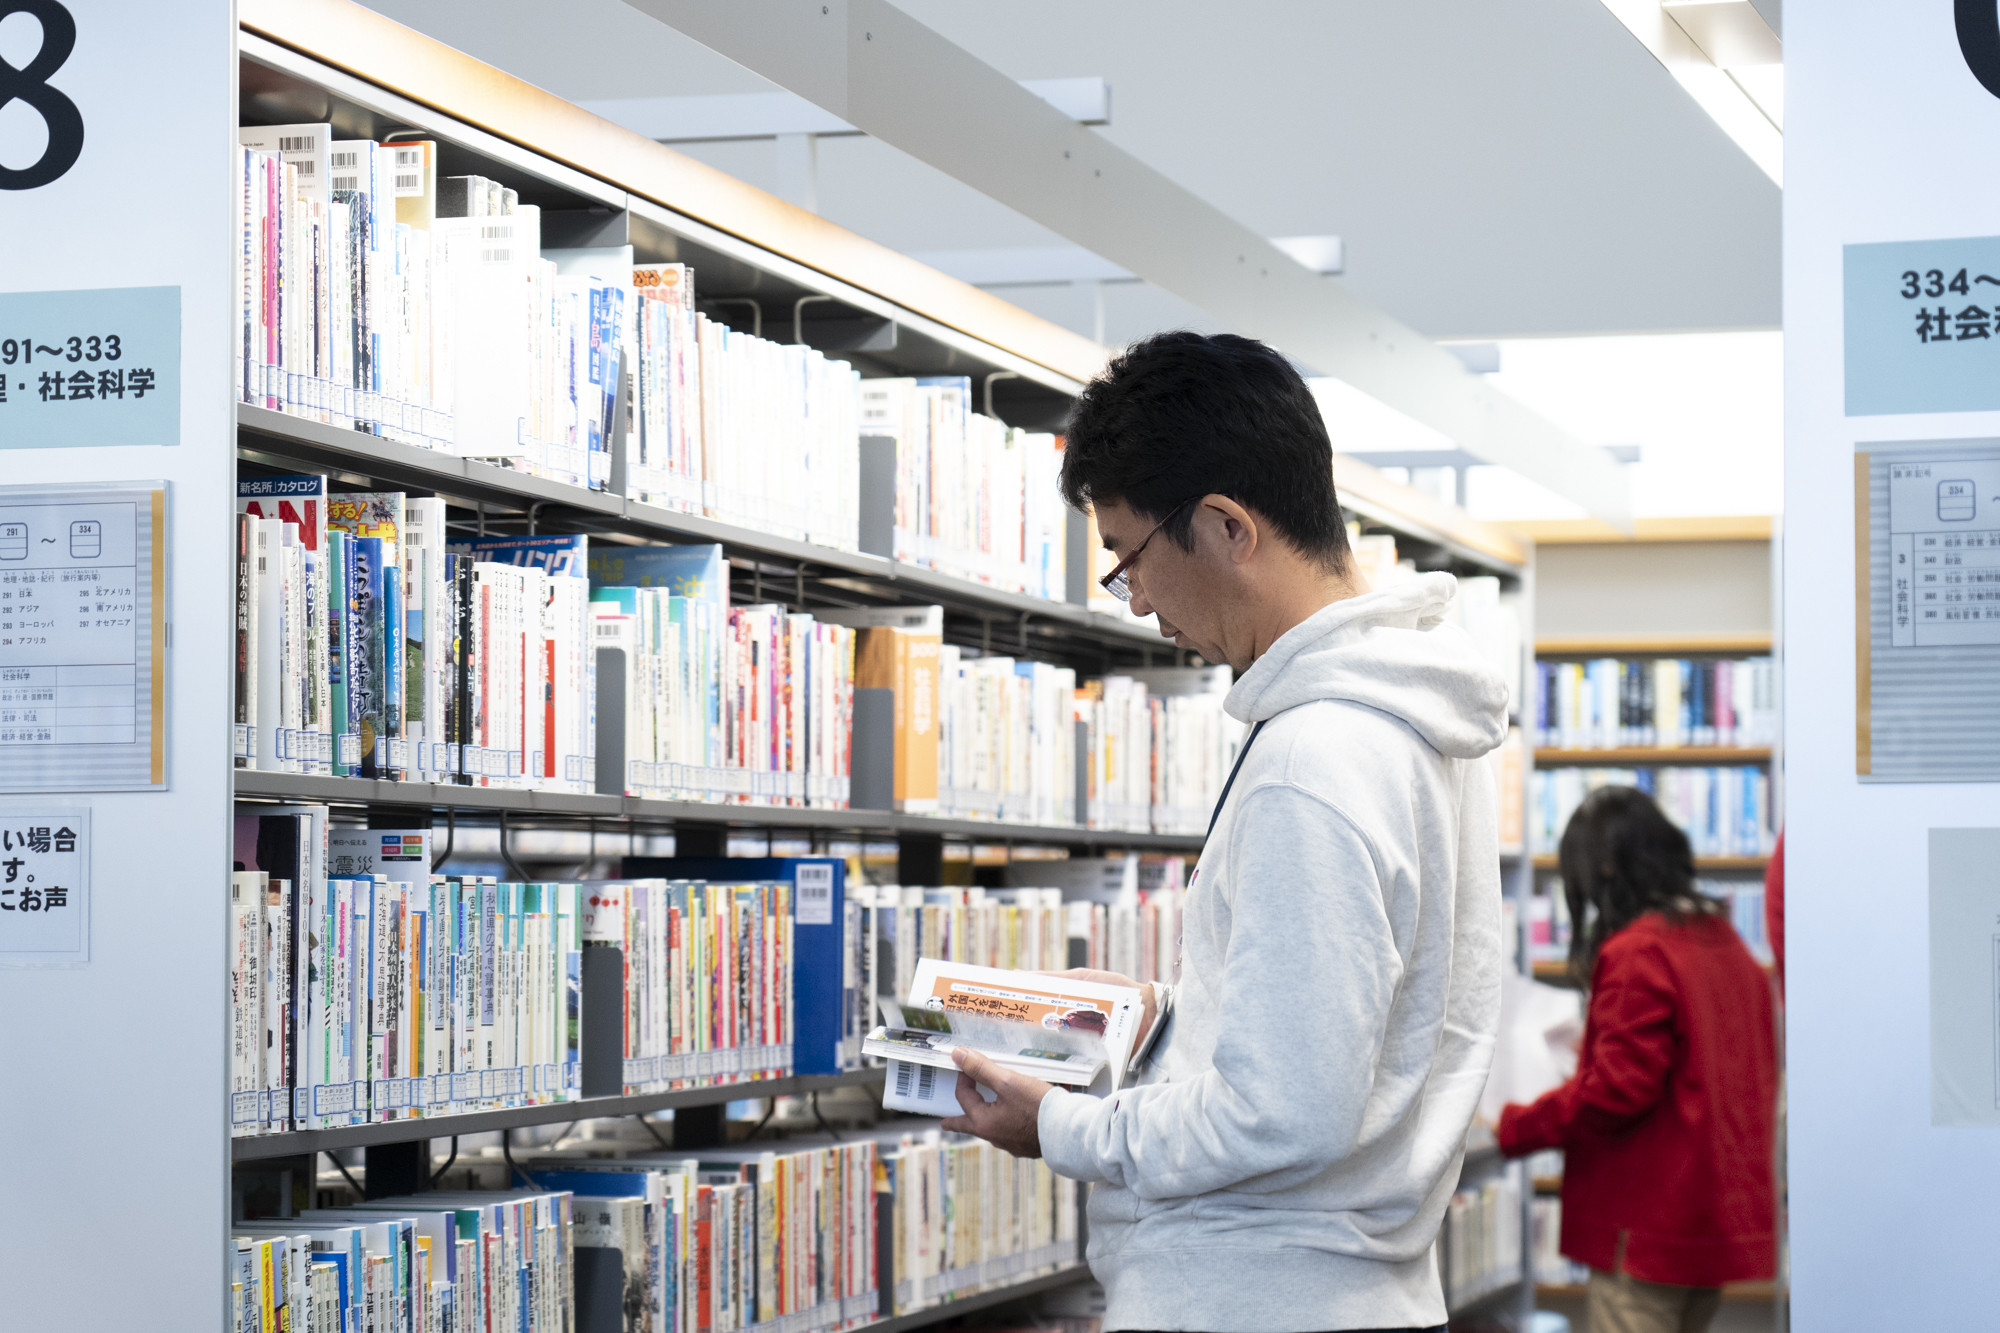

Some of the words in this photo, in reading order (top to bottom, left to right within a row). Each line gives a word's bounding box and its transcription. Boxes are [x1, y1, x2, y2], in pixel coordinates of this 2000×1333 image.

[0, 0, 84, 190] 8
[1915, 303, 2000, 344] 社会
[1949, 486, 1964, 495] 334
[6, 528, 18, 536] 291
[79, 525, 91, 533] 334
[19, 590, 33, 598] 日本
[95, 588, 131, 597] 北アメリカ
[238, 562, 248, 631] 日本の海賊
[19, 605, 39, 613] アジア
[96, 604, 133, 613] 南アメリカ
[1897, 579, 1909, 628] 社会科学
[19, 620, 54, 629] ヨーロッパ
[79, 620, 89, 628] 297
[95, 619, 131, 628] オセアニア
[19, 637, 47, 645] アフリカ
[2, 673, 31, 681] 社会科学
[3, 826, 77, 853] い場合
[2, 857, 35, 883] す。
[301, 840, 311, 943] 日本の名景100
[377, 893, 387, 1027] 北海道の不思議事典
[484, 892, 496, 1016] 秋田県の不思議事典
[234, 1006, 243, 1058] 鉄道旅
